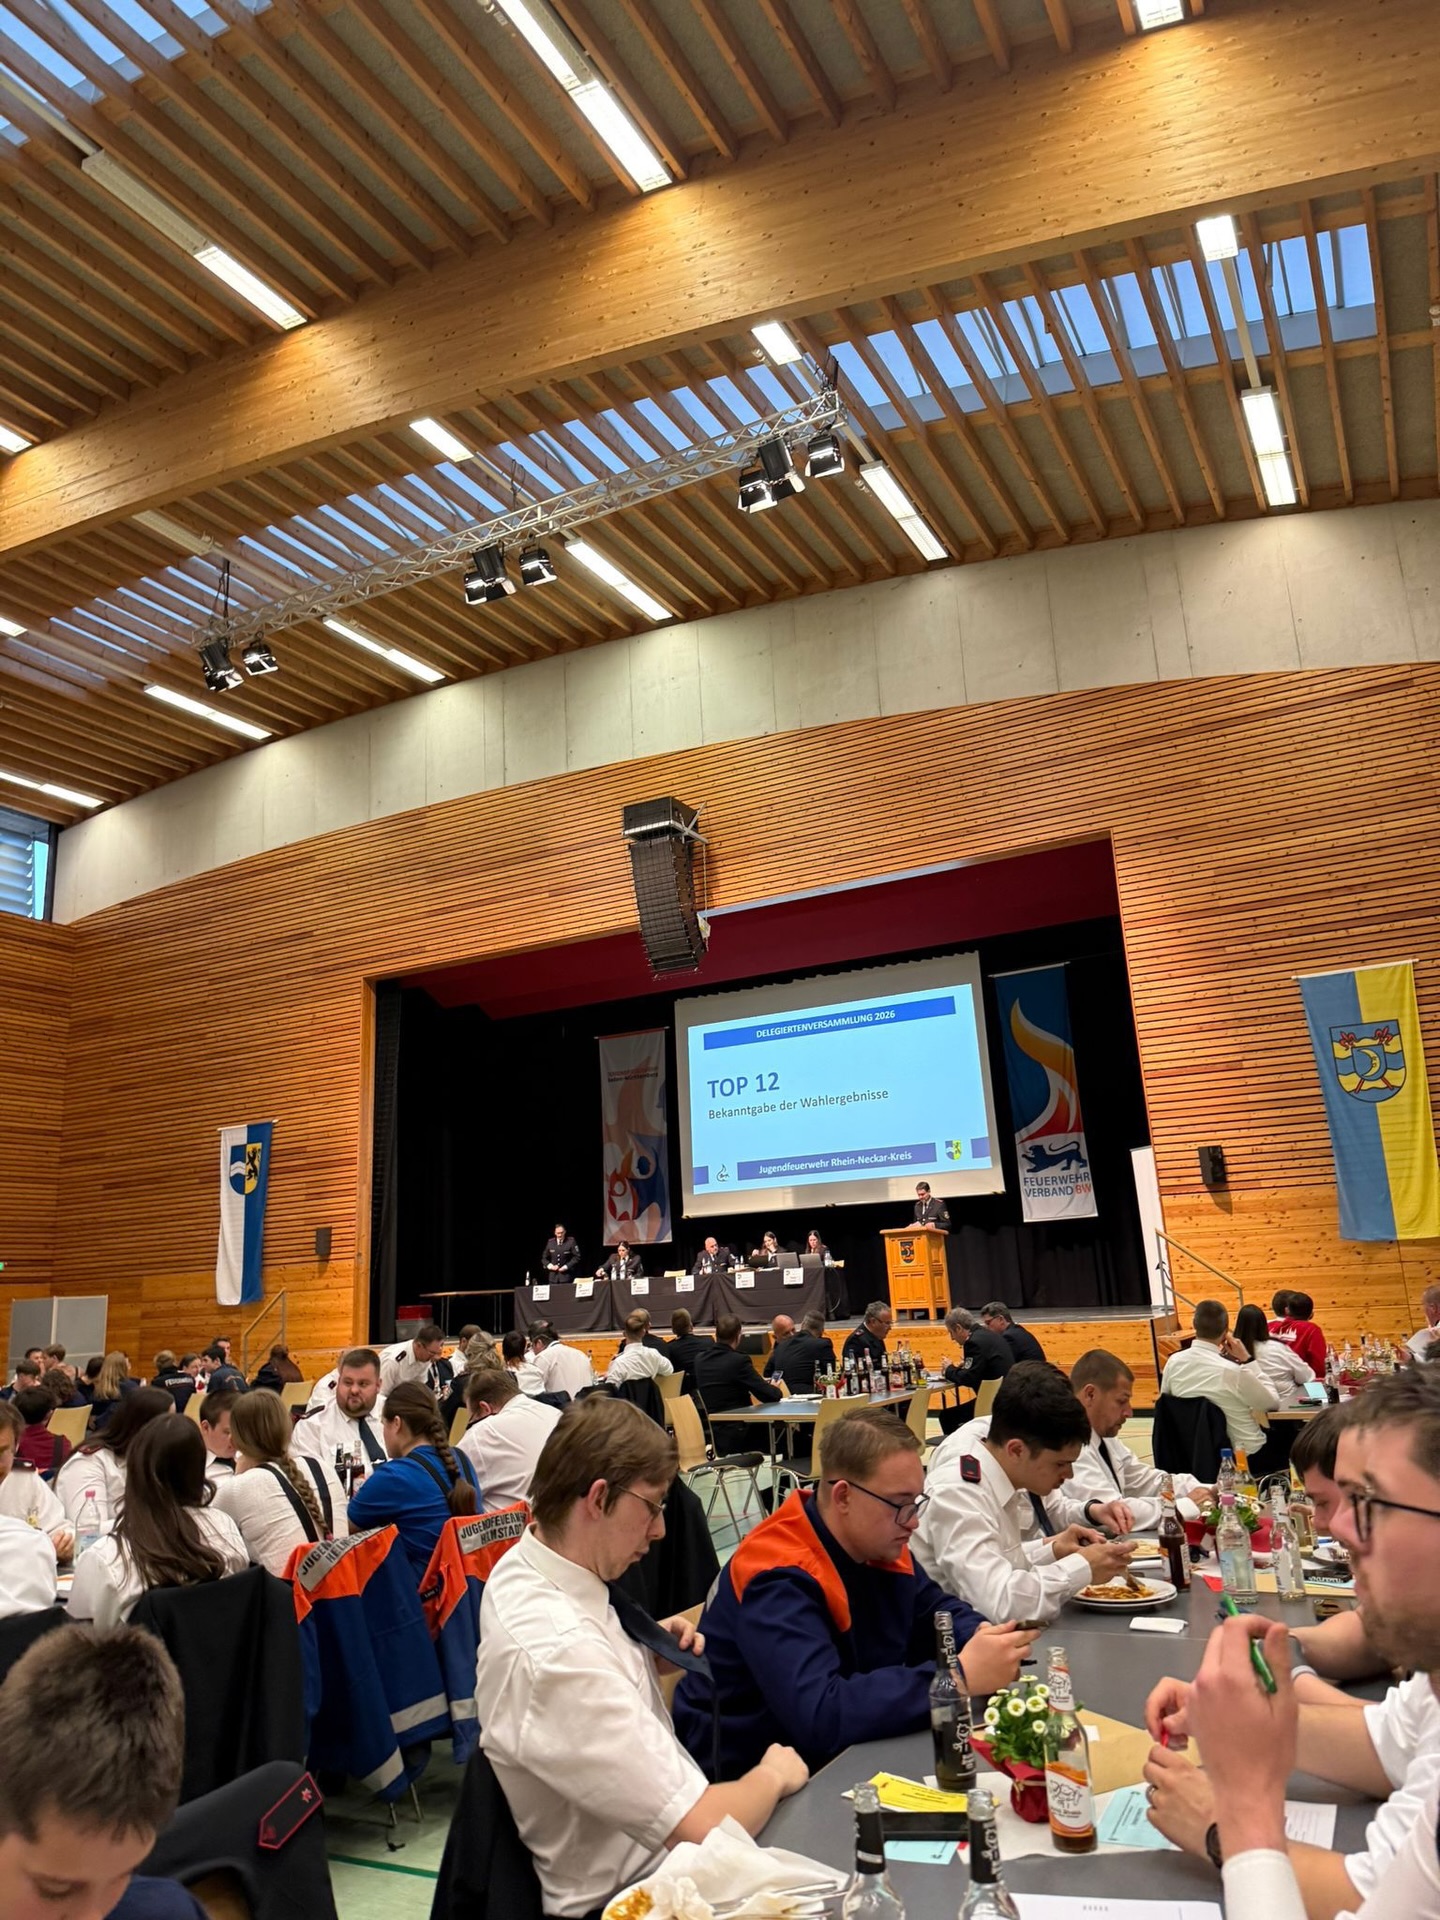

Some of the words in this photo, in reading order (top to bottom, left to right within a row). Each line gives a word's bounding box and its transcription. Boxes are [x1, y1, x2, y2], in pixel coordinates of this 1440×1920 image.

[756, 1013, 873, 1038] DELEGIERTENVERSAMMLUNG
[874, 1010, 896, 1021] 2026
[707, 1076, 749, 1099] TOP
[755, 1071, 780, 1093] 12
[708, 1103, 777, 1120] Bekanntgabe
[779, 1099, 798, 1111] der
[799, 1089, 889, 1108] Wahlergebnisse
[759, 1158, 829, 1175] Jugendfeuerwehr
[830, 1150, 912, 1167] Rhein-Neckar-Kreis
[1023, 1172, 1091, 1187] FEUERWEHR
[1025, 1185, 1074, 1198] VERBAND
[1074, 1183, 1092, 1195] BW
